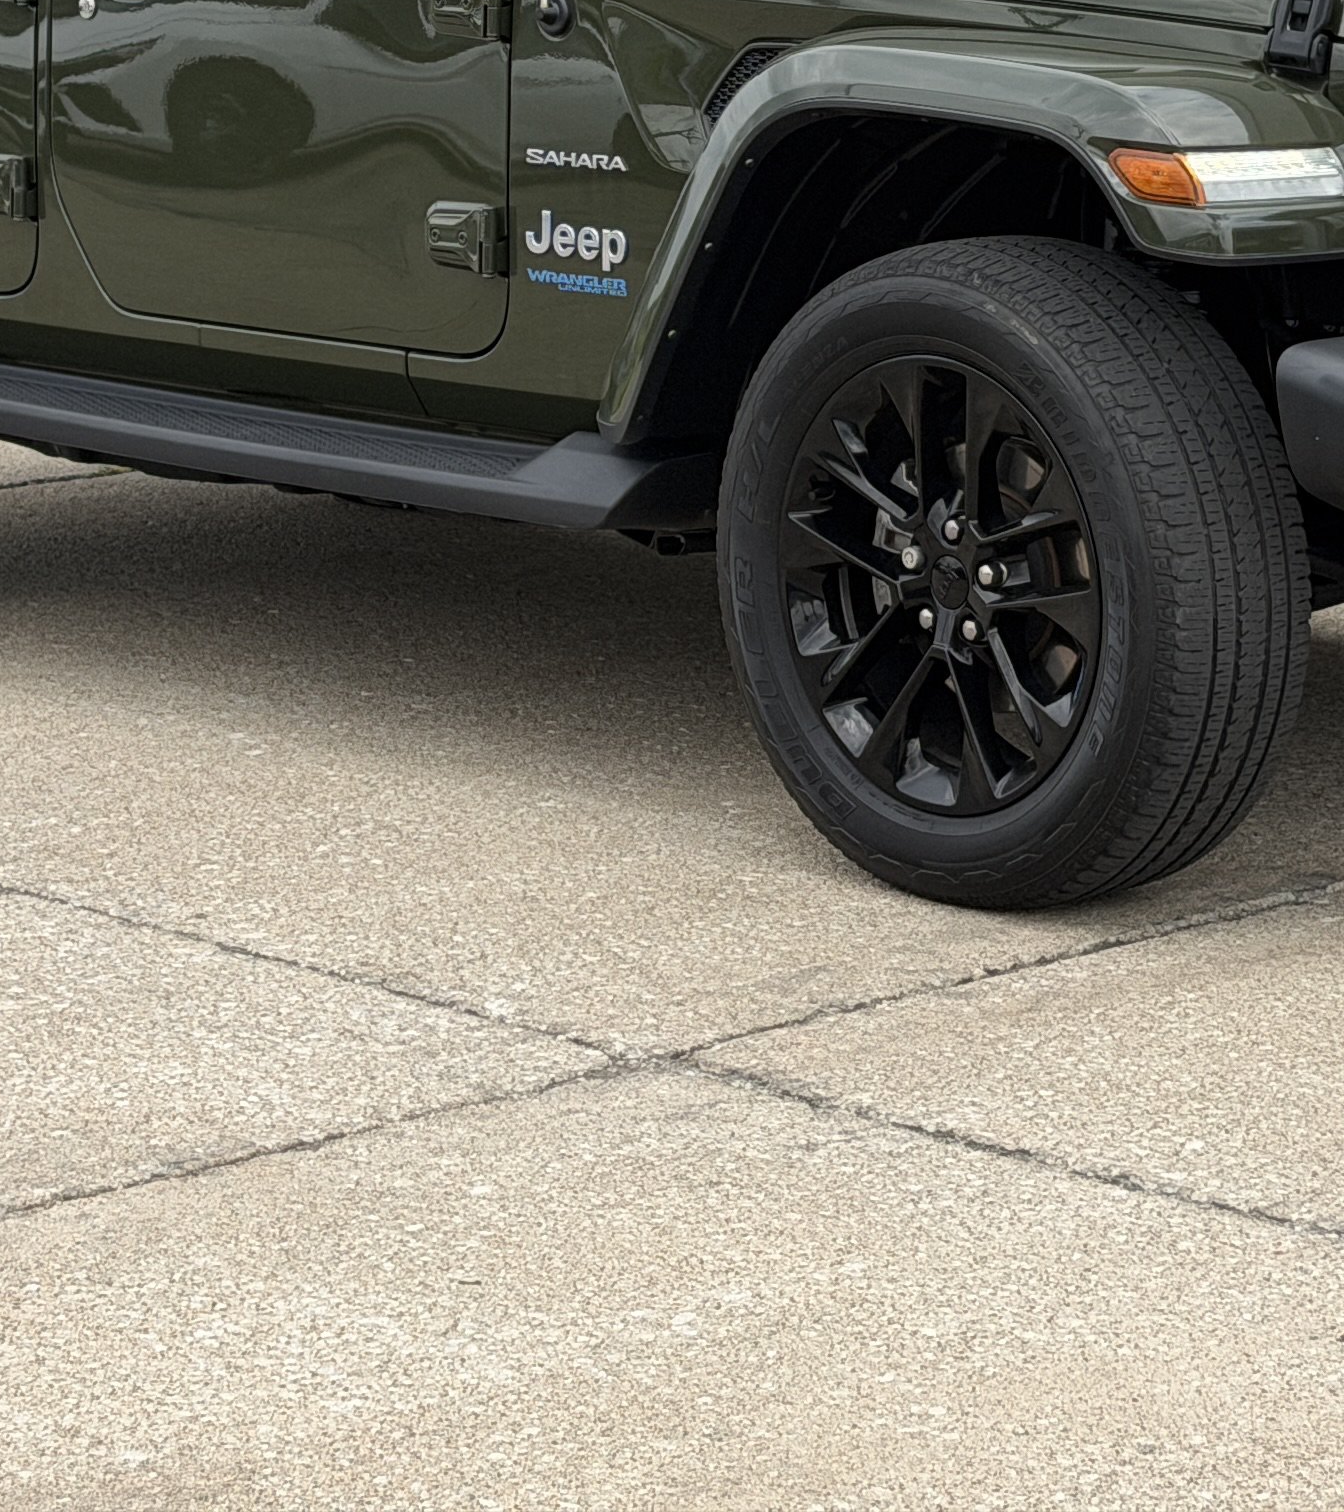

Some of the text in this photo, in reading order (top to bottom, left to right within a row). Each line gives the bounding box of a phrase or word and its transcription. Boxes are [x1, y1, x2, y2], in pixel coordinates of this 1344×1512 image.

[525, 148, 628, 172] SAHARA
[525, 209, 629, 273] Jeep
[526, 267, 628, 290] WRANGLER
[558, 282, 628, 297] UNLIMITED
